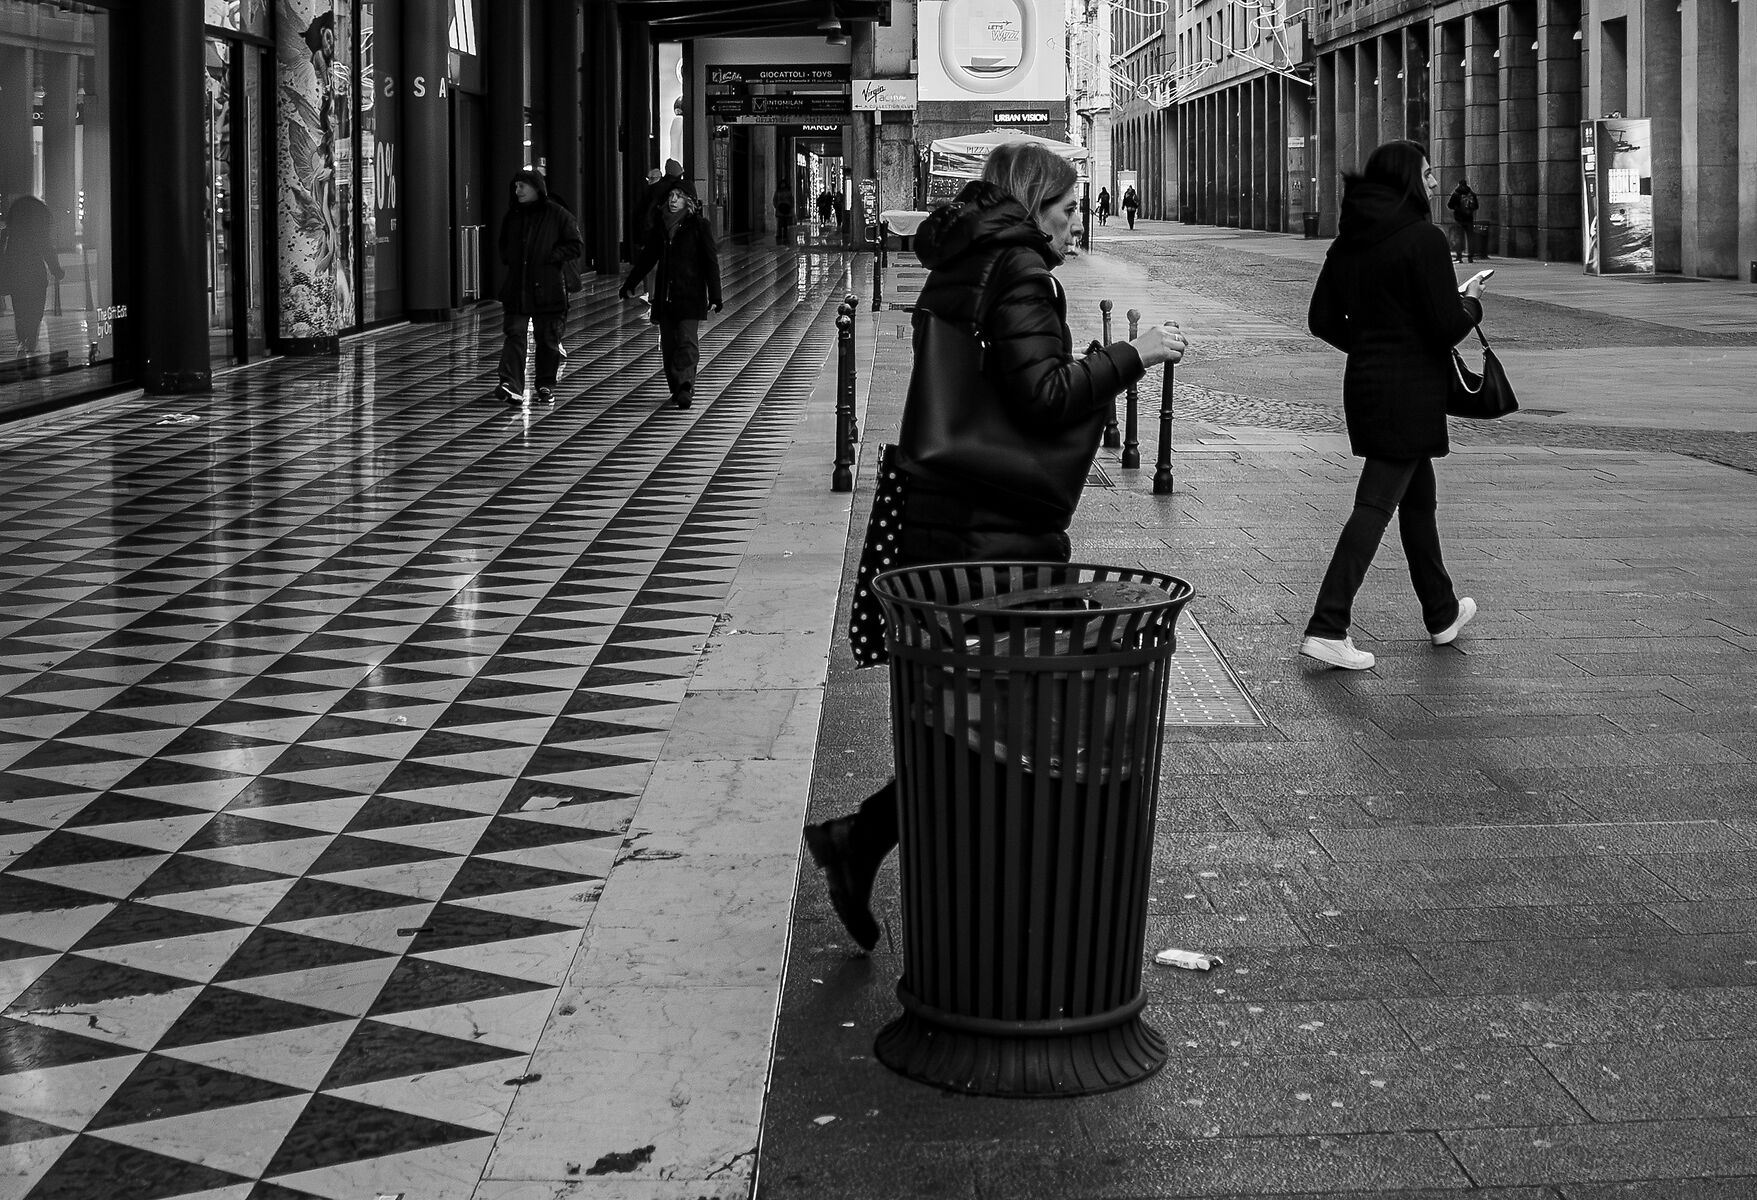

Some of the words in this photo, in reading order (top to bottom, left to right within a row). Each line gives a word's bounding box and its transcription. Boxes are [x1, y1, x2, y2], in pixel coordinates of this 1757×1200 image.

[862, 81, 886, 103] Virgin
[994, 113, 1021, 122] URBAN
[1022, 112, 1048, 122] VISION
[966, 146, 990, 154] PIZZA
